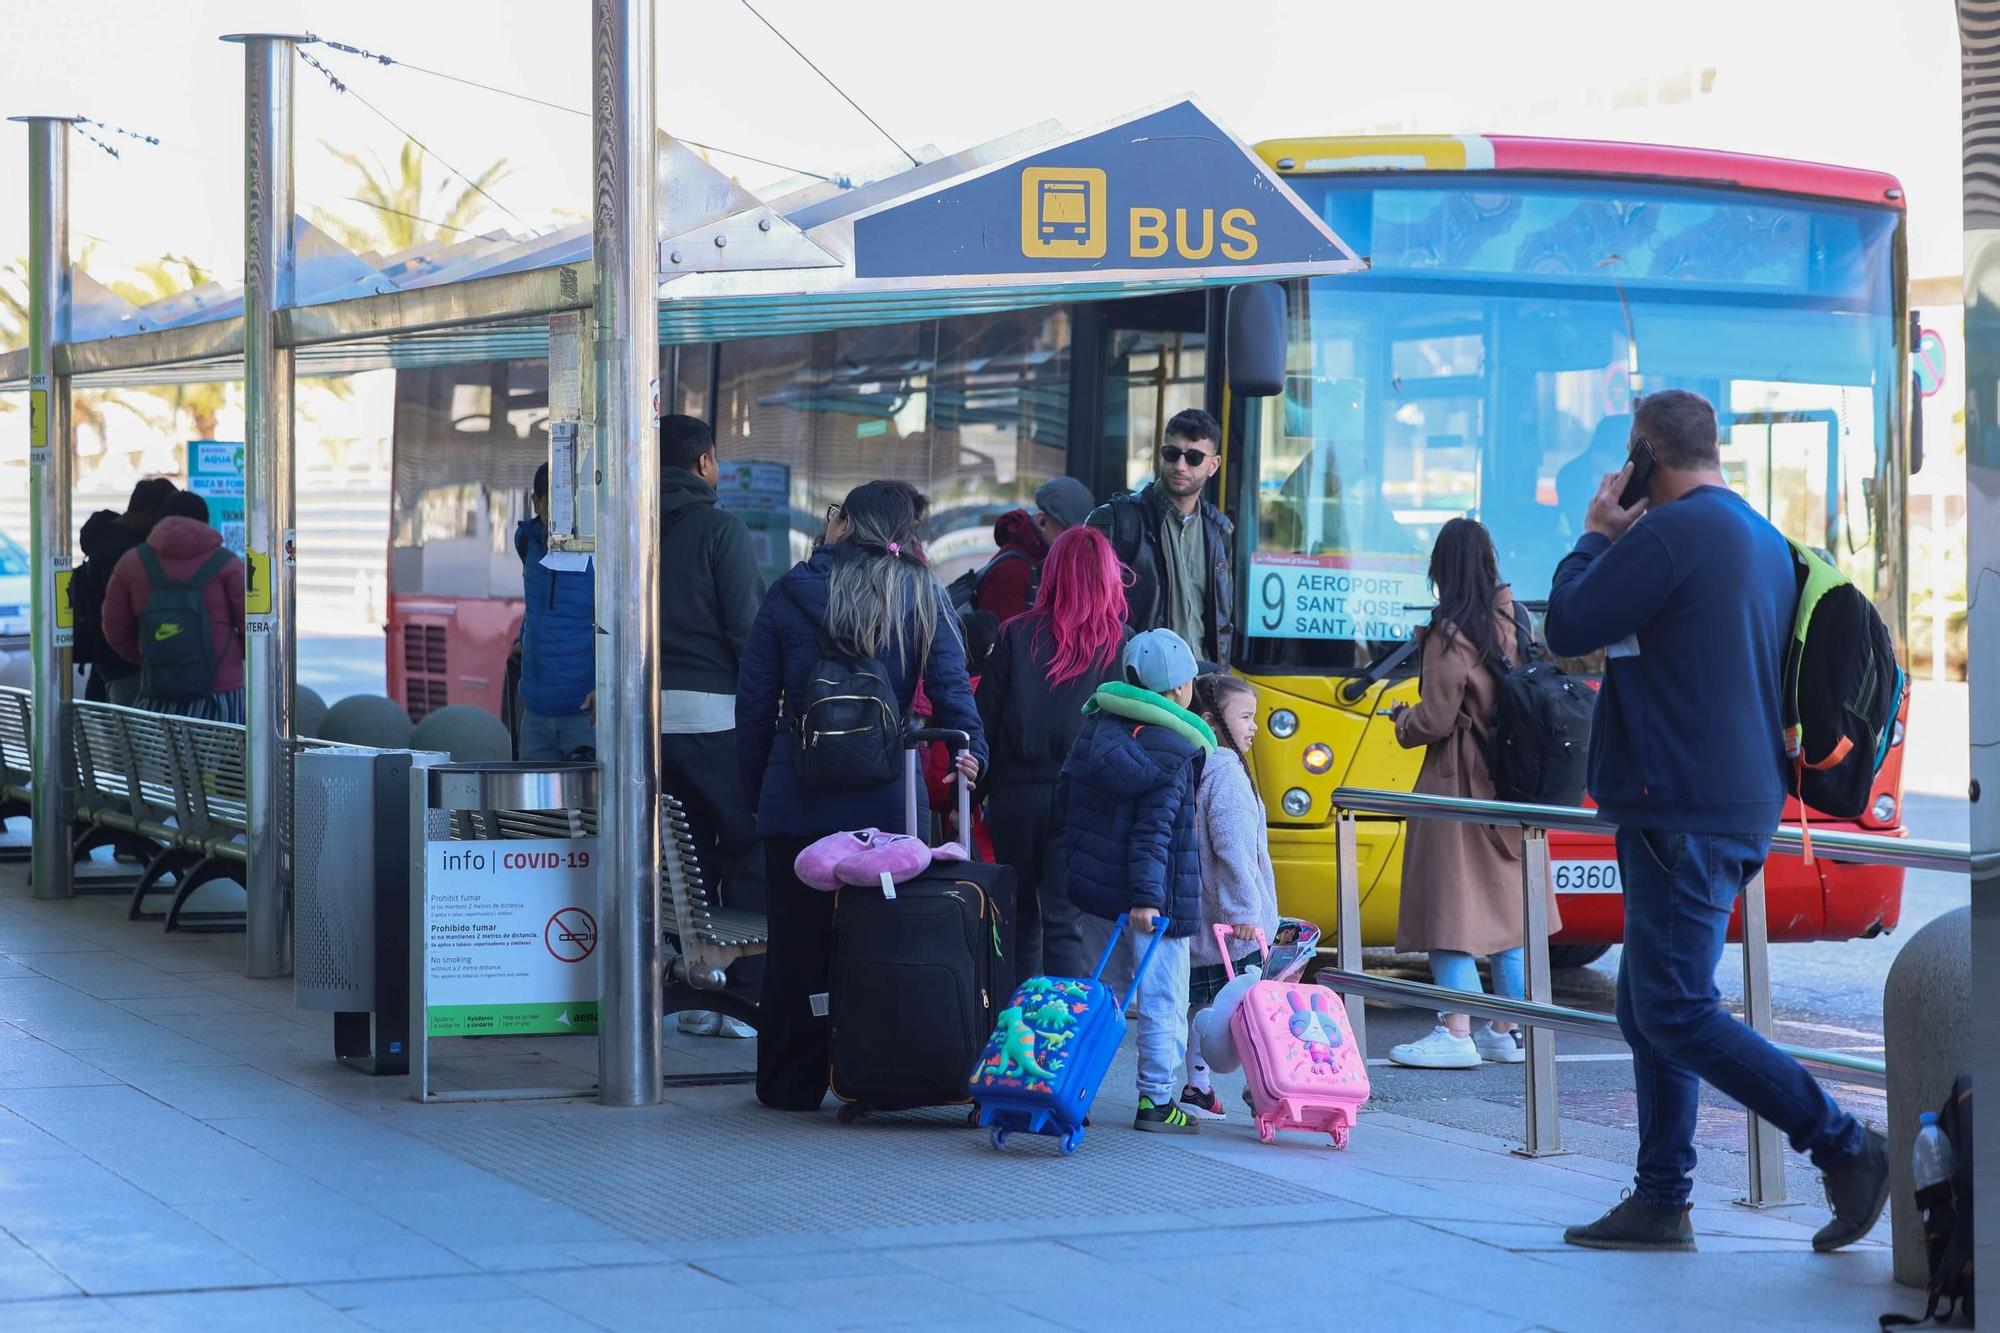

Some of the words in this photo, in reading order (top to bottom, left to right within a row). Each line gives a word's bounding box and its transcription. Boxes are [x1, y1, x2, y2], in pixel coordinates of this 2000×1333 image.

[1129, 207, 1258, 260] BUS
[30, 375, 46, 385] ORT
[204, 455, 232, 464] AQUA
[1296, 574, 1403, 596] AEROPORT
[1261, 572, 1286, 631] 9
[1295, 596, 1347, 613] SANT
[1352, 599, 1414, 617] JOSEP
[1295, 616, 1347, 635] SANT
[443, 850, 485, 871] info
[503, 851, 590, 869] COVID-19
[1555, 865, 1616, 889] 6360
[431, 894, 459, 902] Prohibit
[460, 894, 481, 902] fumar
[431, 924, 470, 932] Prohibido
[431, 956, 441, 964] No
[442, 956, 472, 964] smoking
